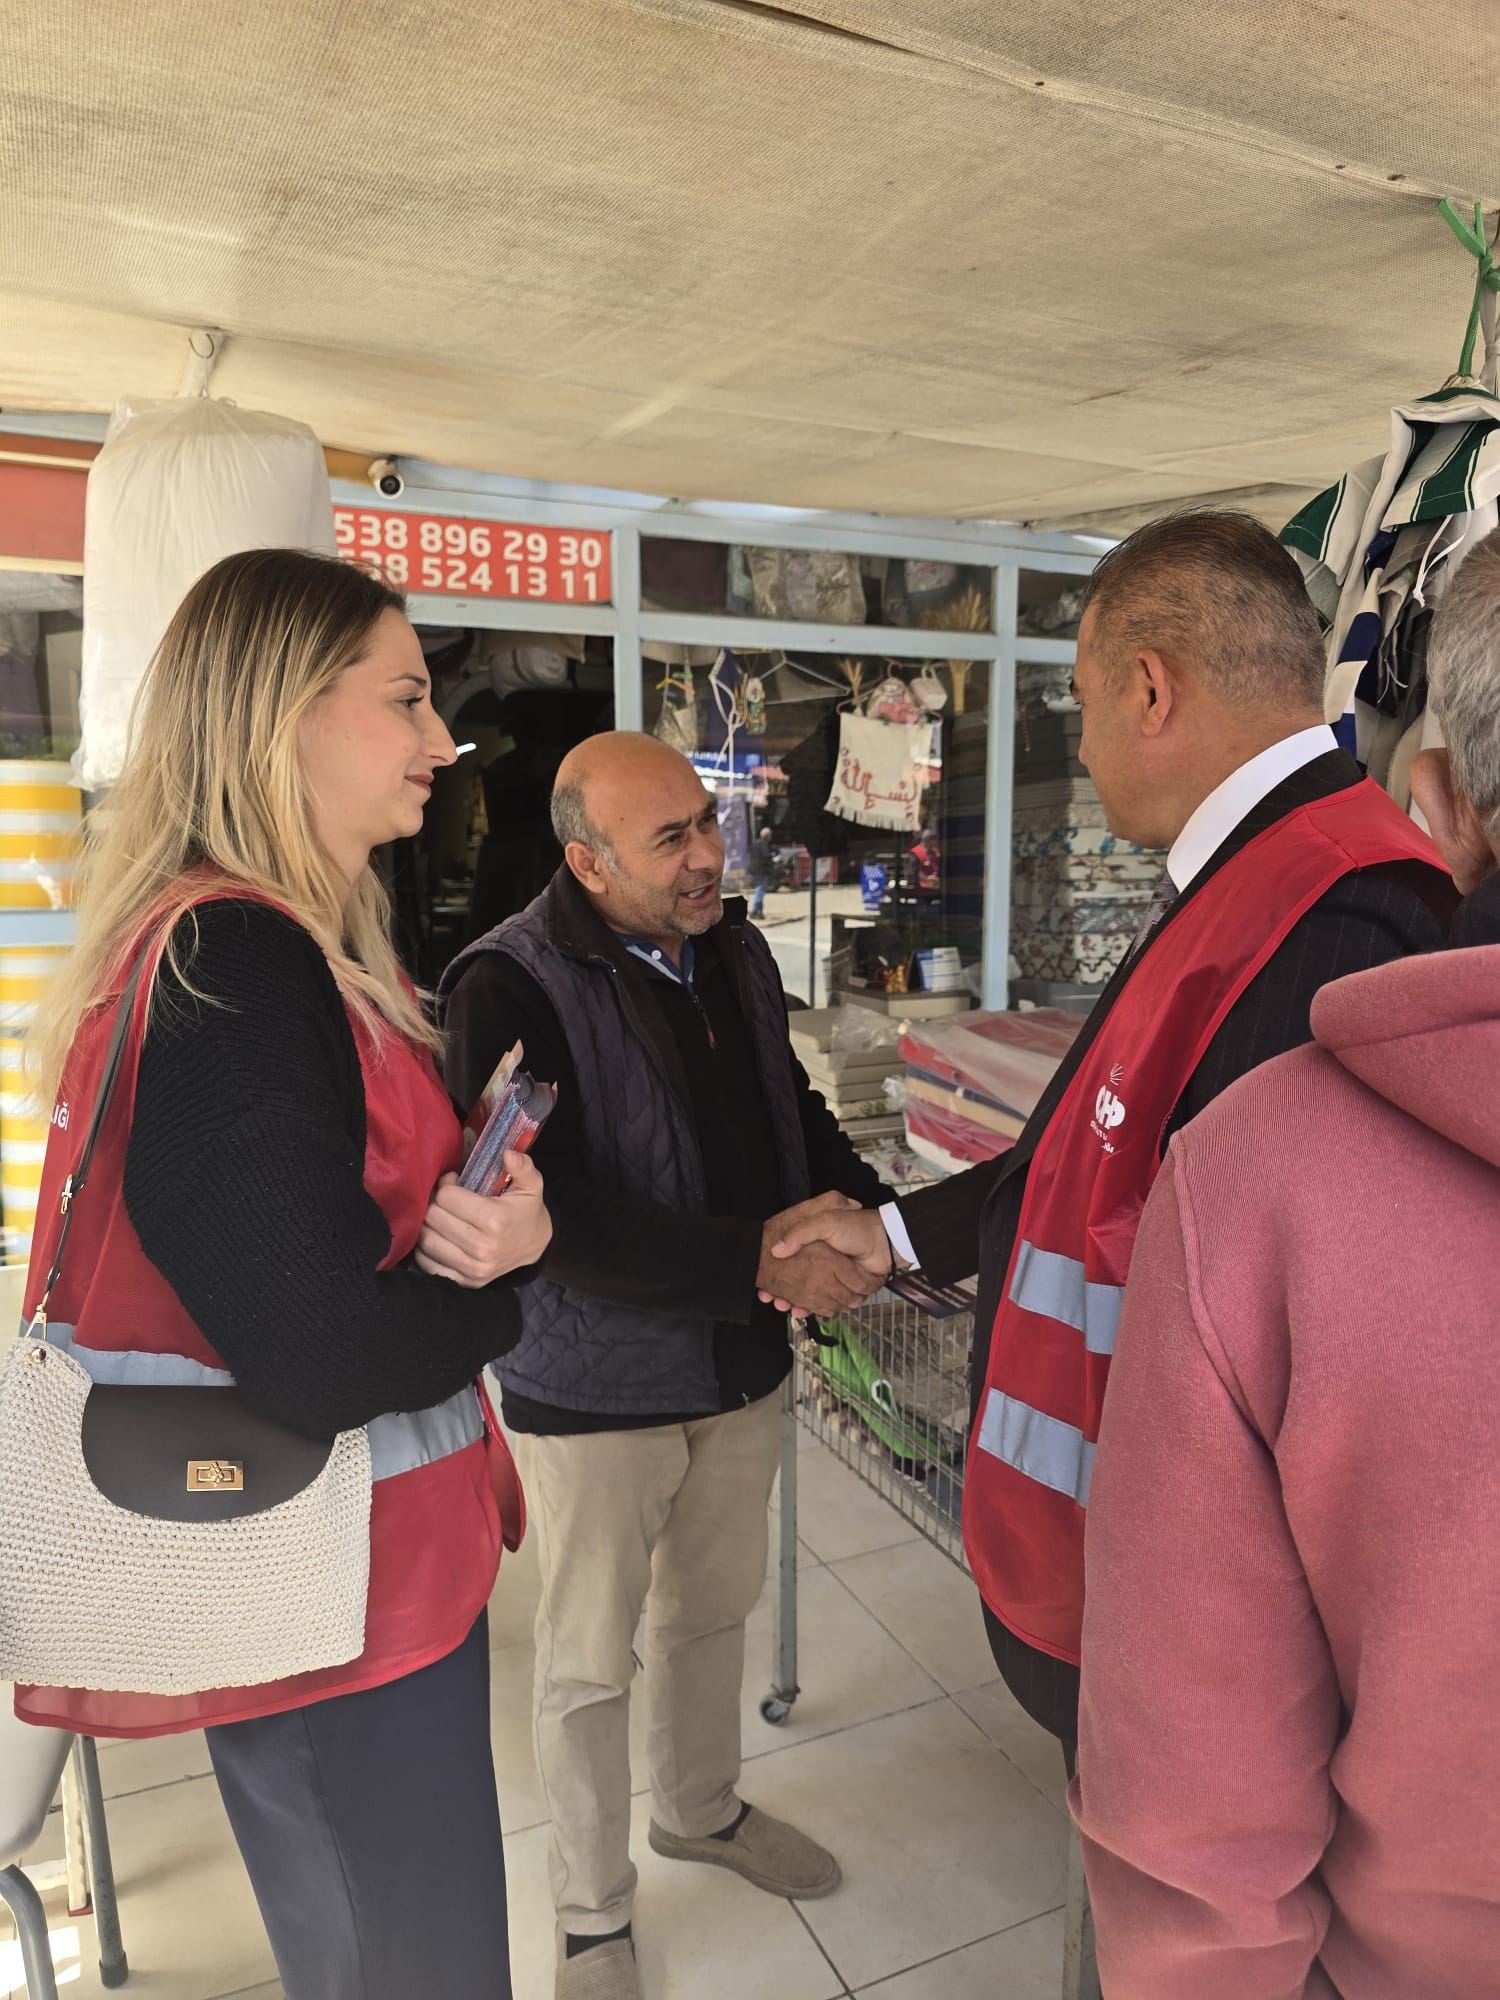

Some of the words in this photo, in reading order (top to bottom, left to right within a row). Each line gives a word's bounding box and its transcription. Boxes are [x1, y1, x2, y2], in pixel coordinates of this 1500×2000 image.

[334, 512, 408, 550] 538
[420, 521, 492, 558] 896
[503, 529, 548, 563] 29
[559, 535, 602, 568] 30
[422, 556, 493, 592] 524
[506, 564, 548, 597] 13
[561, 570, 597, 601] 11
